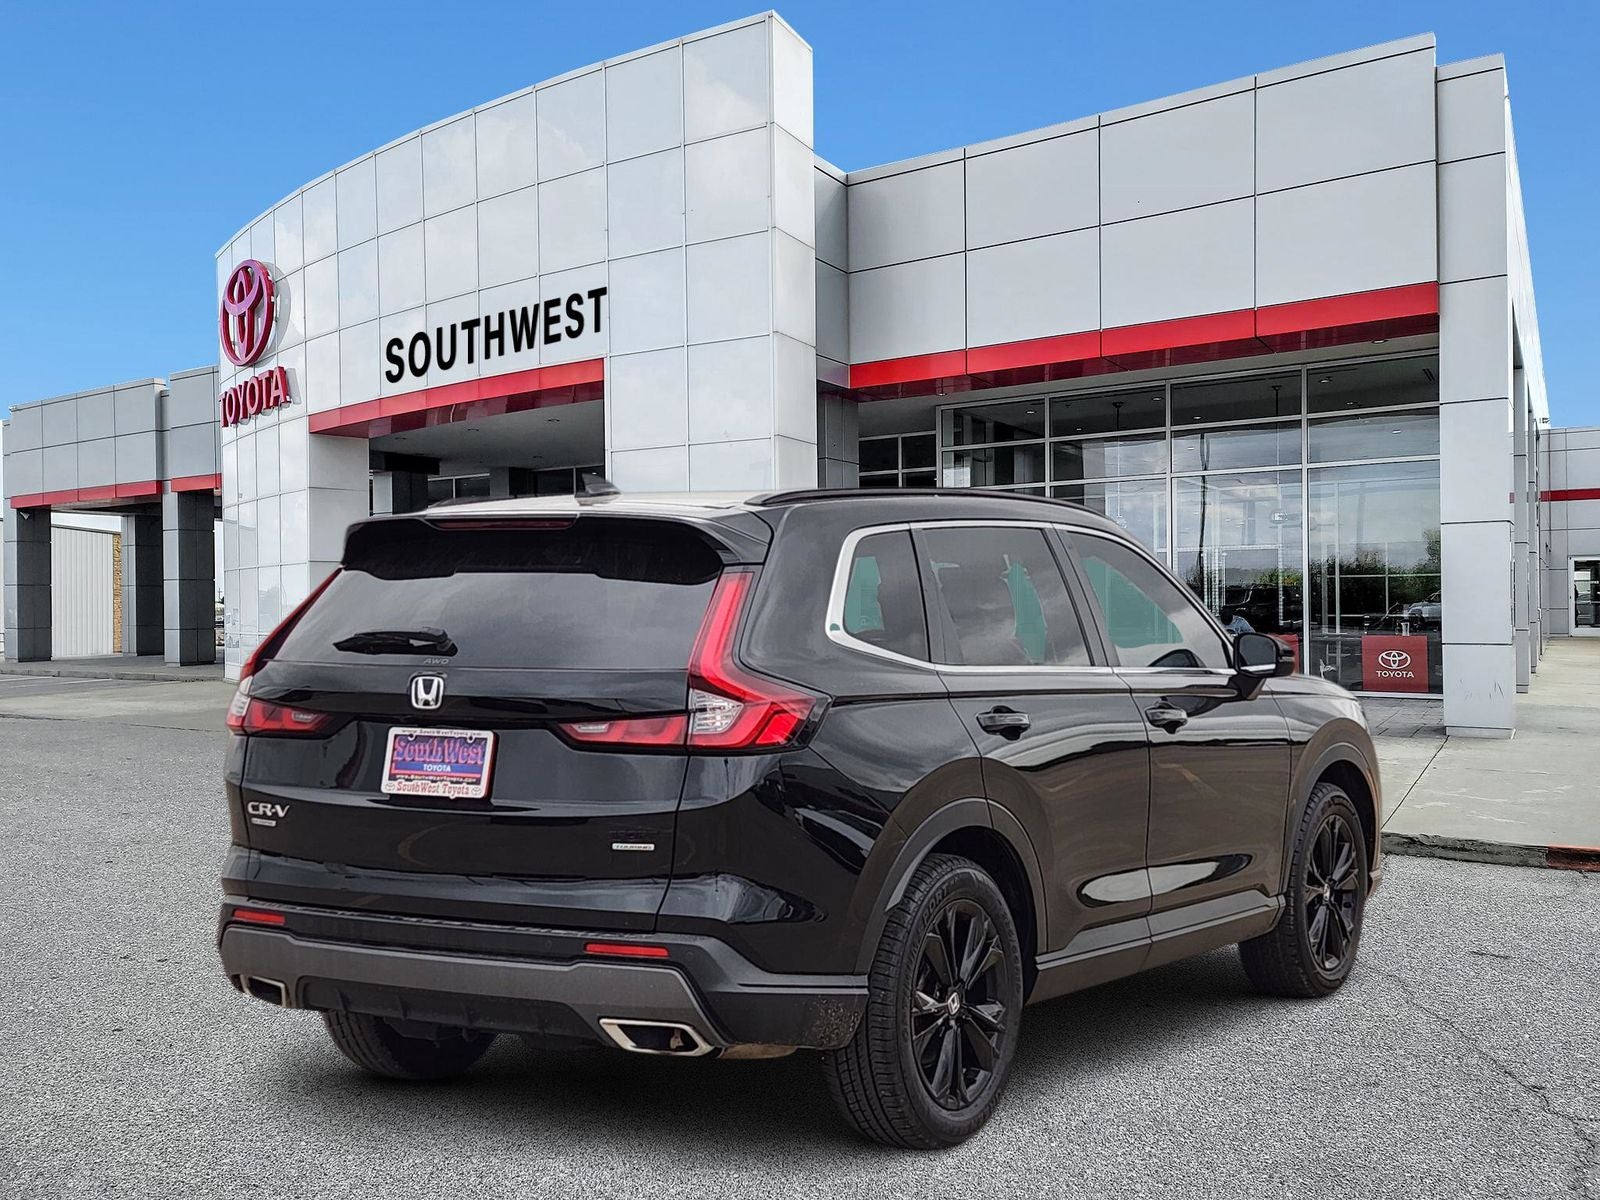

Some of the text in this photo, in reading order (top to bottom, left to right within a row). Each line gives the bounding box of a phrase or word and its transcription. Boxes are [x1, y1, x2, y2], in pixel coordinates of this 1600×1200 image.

[385, 287, 608, 384] SOUTHWEST
[218, 366, 291, 428] TOYOTA
[1375, 670, 1415, 678] TOYOTA
[423, 763, 452, 772] TOYOTA
[442, 784, 470, 797] Toyota
[247, 801, 290, 818] CR-V
